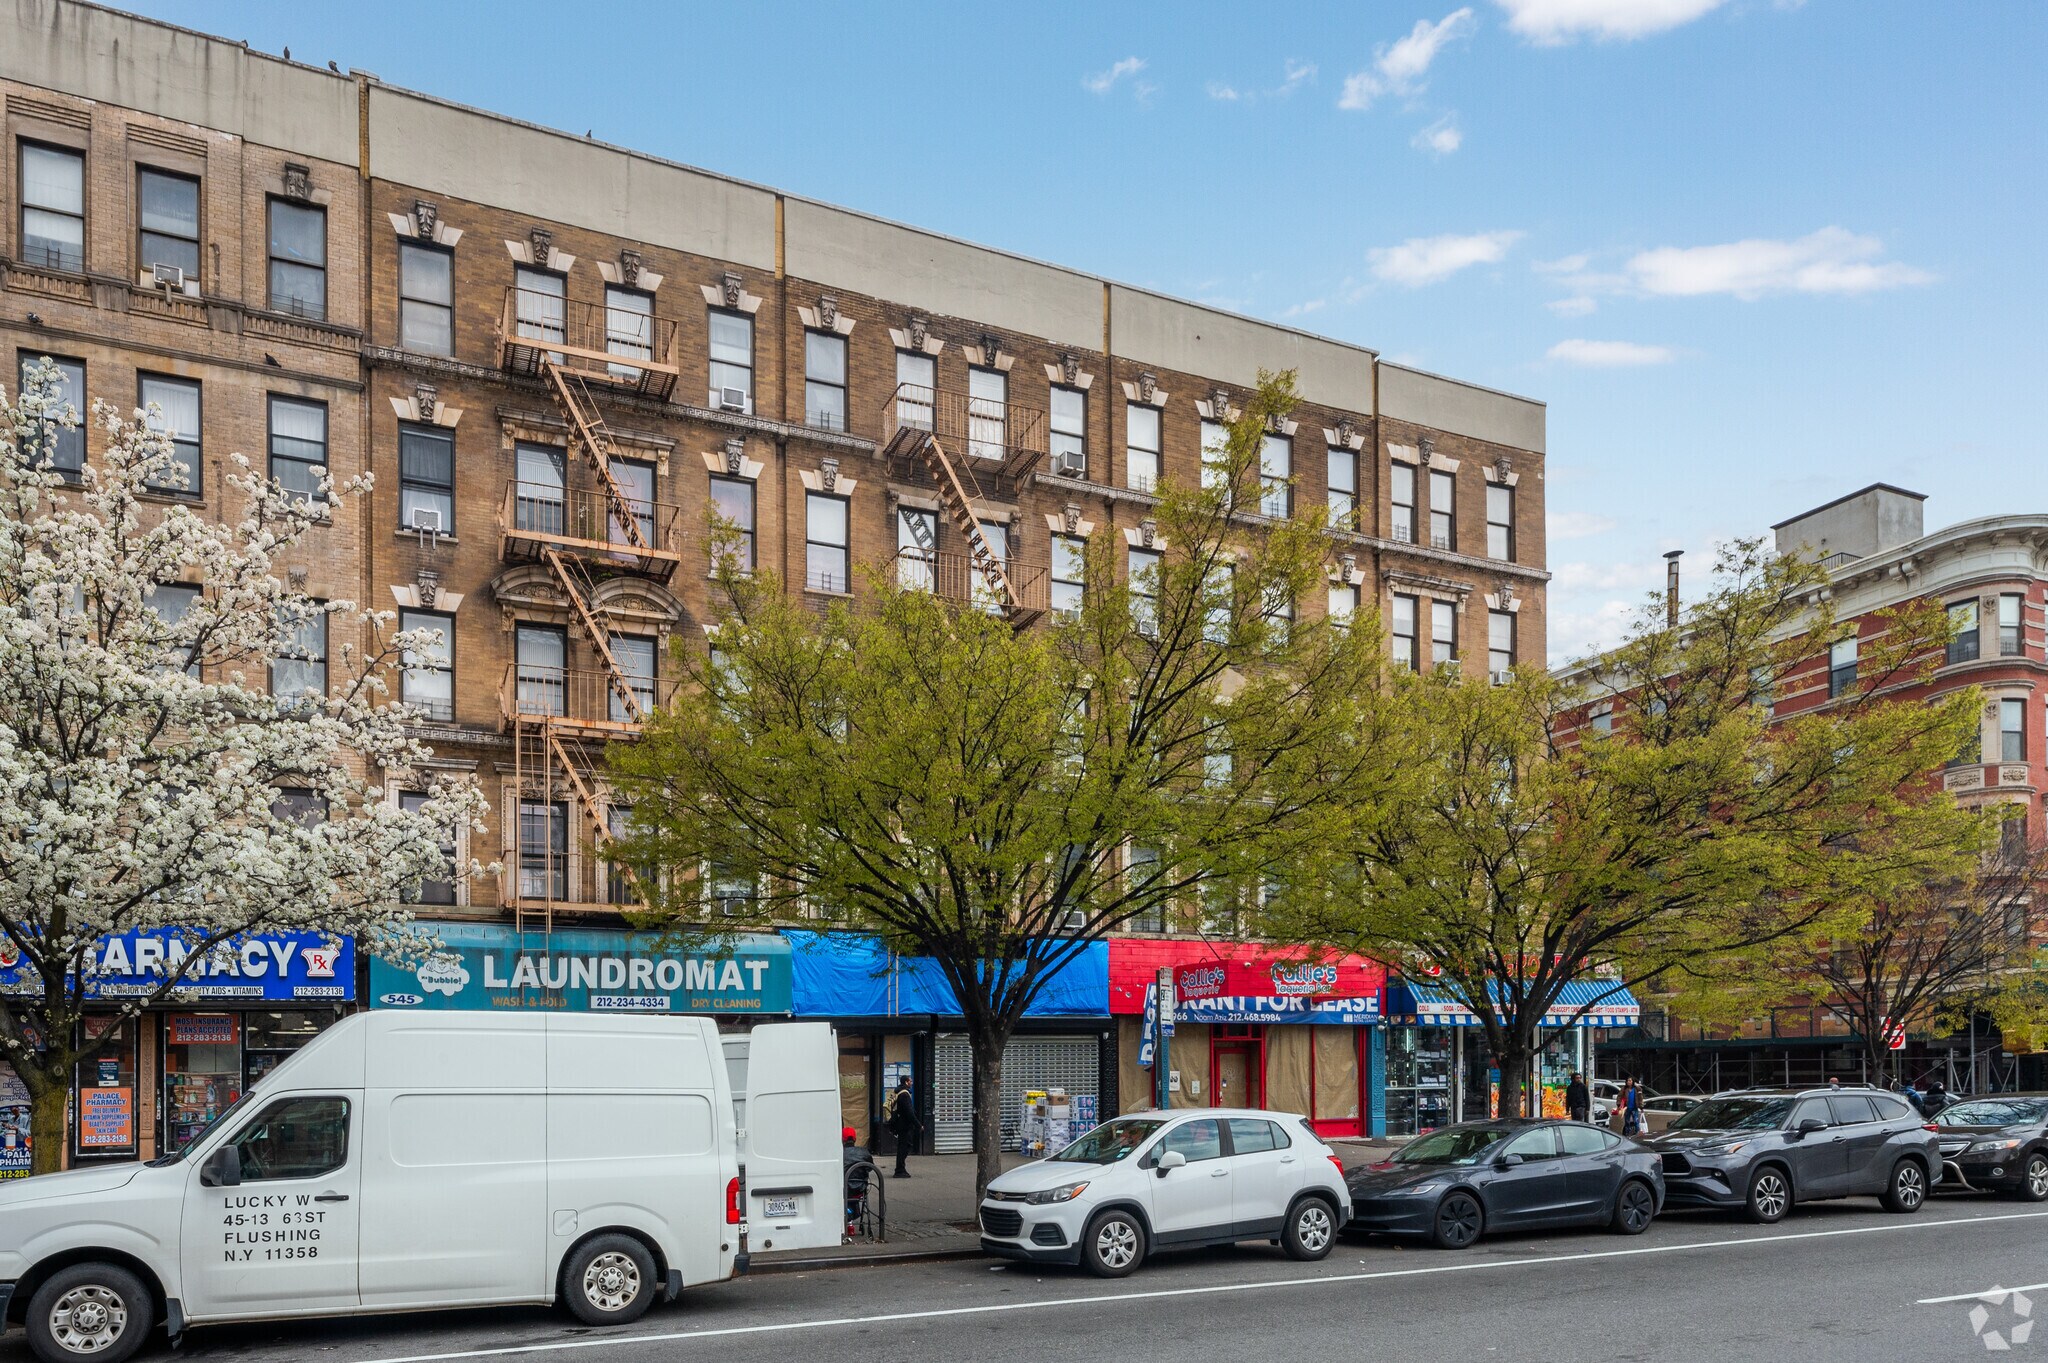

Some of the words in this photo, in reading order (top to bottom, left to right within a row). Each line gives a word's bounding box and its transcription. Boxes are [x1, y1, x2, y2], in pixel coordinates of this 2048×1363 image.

[32, 937, 298, 977] ARMACY
[484, 955, 769, 991] LAUNDROMAT
[1180, 966, 1226, 988] Callie's
[1271, 961, 1338, 984] Callie's
[428, 975, 462, 985] Bubble!
[211, 987, 227, 995] AIDS
[232, 987, 263, 996] VITAMINS
[294, 987, 343, 996] 212-283-2136
[1275, 983, 1315, 995] Taqueria
[387, 994, 415, 1004] 545
[492, 997, 524, 1007] WASH
[529, 998, 537, 1007] &
[540, 997, 567, 1008] FOLD
[596, 997, 665, 1008] 212-234-4334
[691, 998, 710, 1008] DRY
[713, 998, 761, 1008] CLEANING
[1255, 996, 1305, 1012] FOR
[1443, 1003, 1454, 1011] SODA
[175, 1017, 194, 1025] MOST
[196, 1017, 233, 1025] INSURANCE
[1227, 1012, 1282, 1022] 212.468.5984
[176, 1026, 197, 1034] PLANS
[198, 1026, 232, 1034] ACCEPTED
[92, 1092, 120, 1100] PALACE
[224, 1195, 287, 1209] LUCKY
[296, 1194, 311, 1206] W
[223, 1213, 269, 1226] 45-13
[224, 1229, 321, 1244] FLUSHING
[224, 1249, 253, 1262] N.Y
[265, 1246, 318, 1260] 11358
